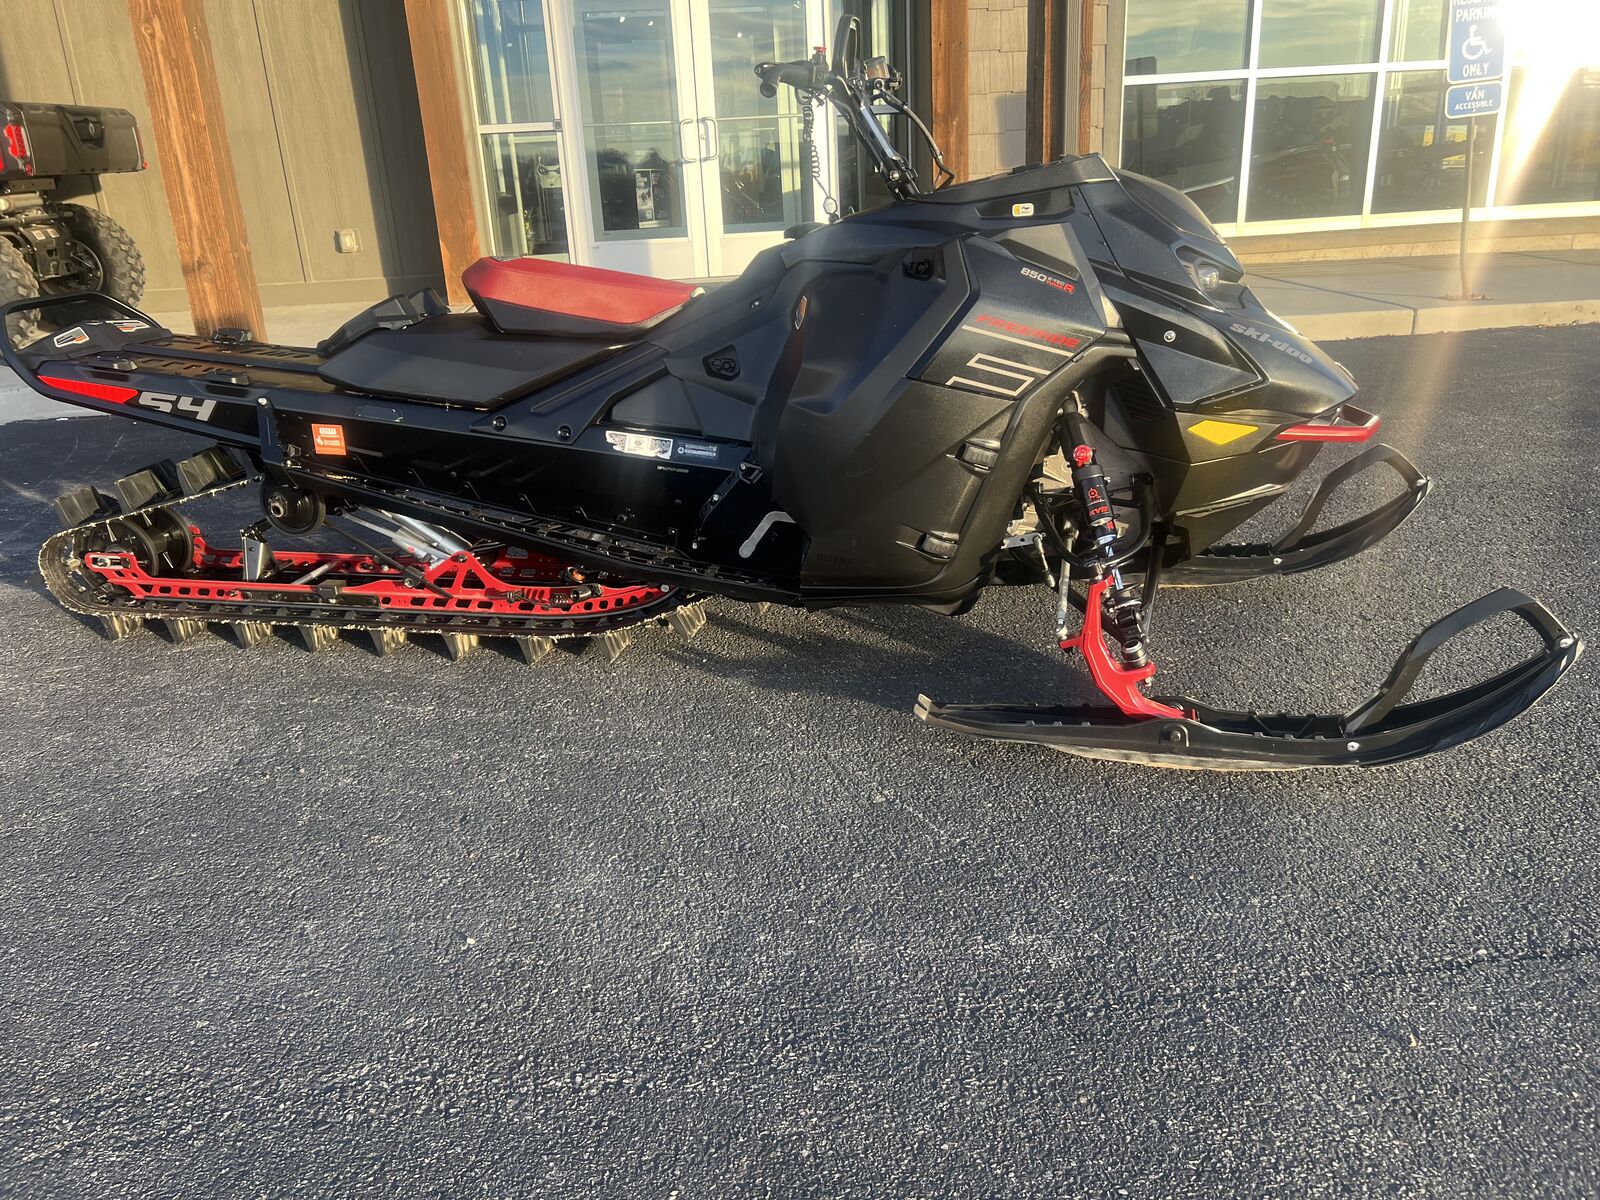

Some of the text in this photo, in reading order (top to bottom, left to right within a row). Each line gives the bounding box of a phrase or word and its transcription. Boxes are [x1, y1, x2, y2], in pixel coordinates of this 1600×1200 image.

[1455, 7, 1498, 23] PARKIN
[1462, 62, 1490, 77] ONLY
[1465, 89, 1485, 101] VAN
[1455, 99, 1493, 111] ACCESSIBLE
[1020, 267, 1047, 282] 850
